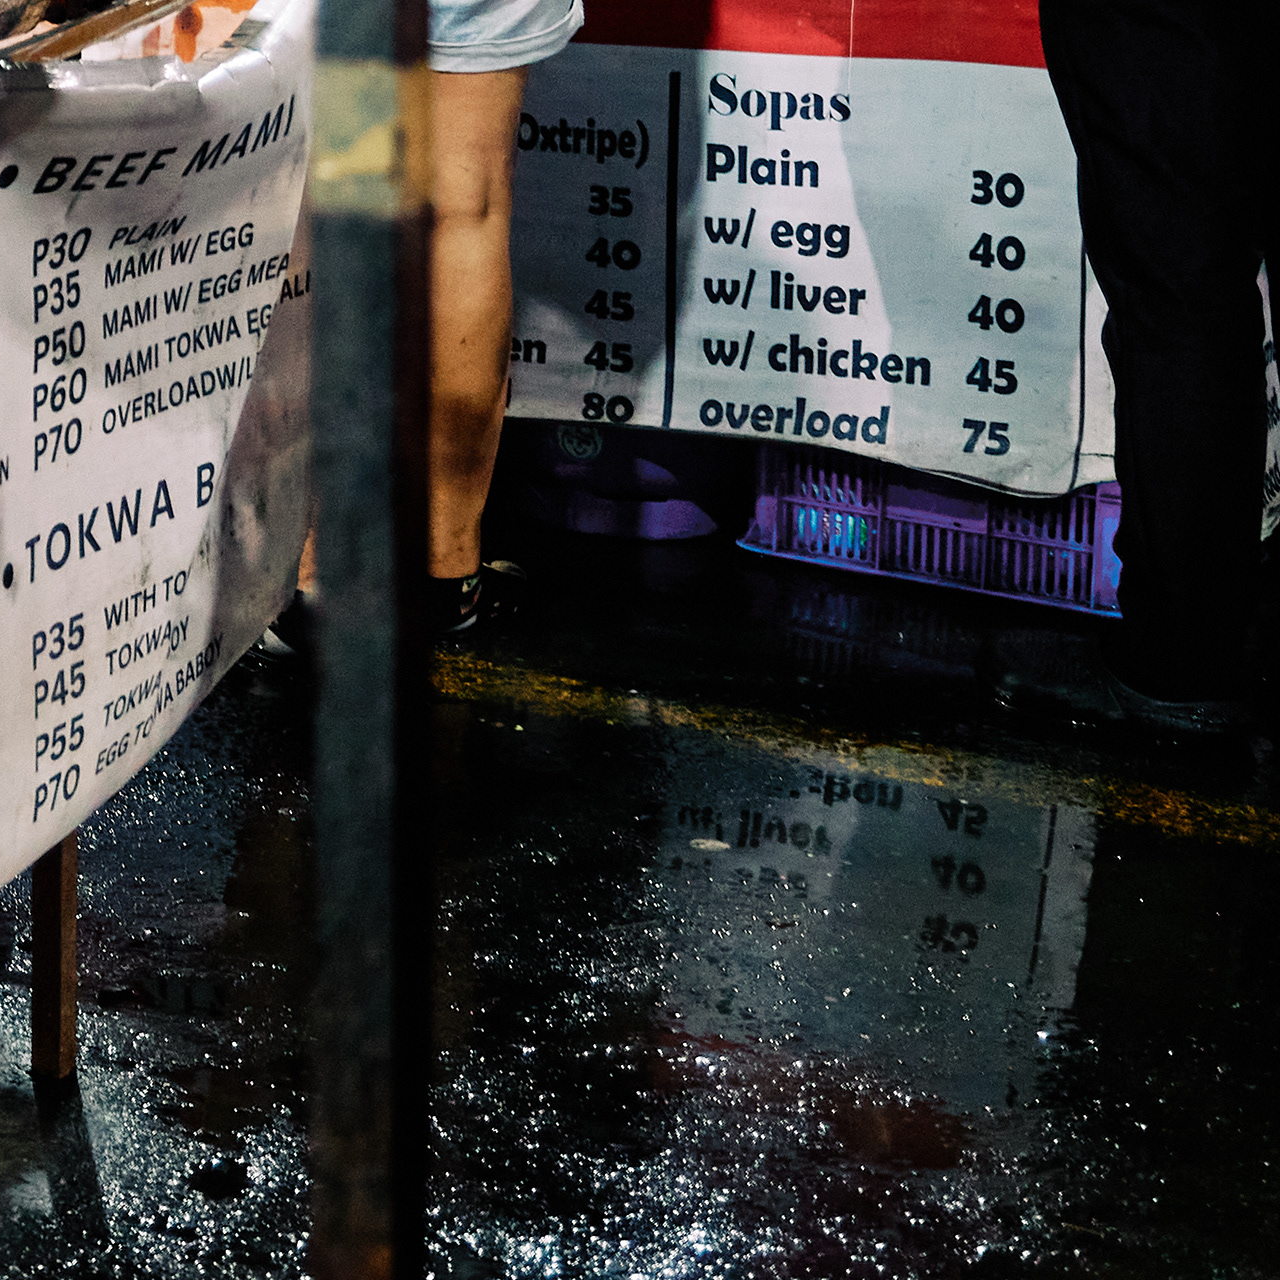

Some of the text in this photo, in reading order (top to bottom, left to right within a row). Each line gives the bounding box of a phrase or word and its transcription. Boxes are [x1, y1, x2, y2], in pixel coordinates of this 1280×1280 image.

[706, 72, 852, 131] Sopas
[33, 94, 297, 195] BEEF MAMI
[705, 143, 1026, 208] Plain 30
[588, 184, 633, 218] 35
[32, 215, 188, 278] P30 PLAIN
[585, 237, 641, 270] 40
[703, 208, 1027, 272] w/ egg 40
[32, 222, 255, 325] P35 MAMI W/ EGG
[583, 288, 635, 321] 45
[703, 269, 1026, 334] w/ liver 40
[32, 320, 87, 375] P50
[102, 292, 159, 341] MAMI
[164, 280, 193, 313] W/
[197, 268, 243, 305] EGG
[32, 366, 88, 422] P60
[104, 342, 159, 389] MAMI
[165, 314, 242, 367] TOKWA
[583, 340, 634, 374] 45
[702, 330, 1019, 396] w/ chicken 45
[582, 392, 635, 424] 80
[698, 396, 1011, 457] overload 75
[33, 418, 83, 471] P70
[24, 478, 175, 584] TOKWA
[32, 611, 85, 671] P35
[103, 583, 157, 631] WITH
[34, 620, 172, 720] P45 TOKWA
[35, 669, 163, 773] P55 TOKWA
[33, 764, 81, 823] P70
[94, 731, 131, 776] EGG
